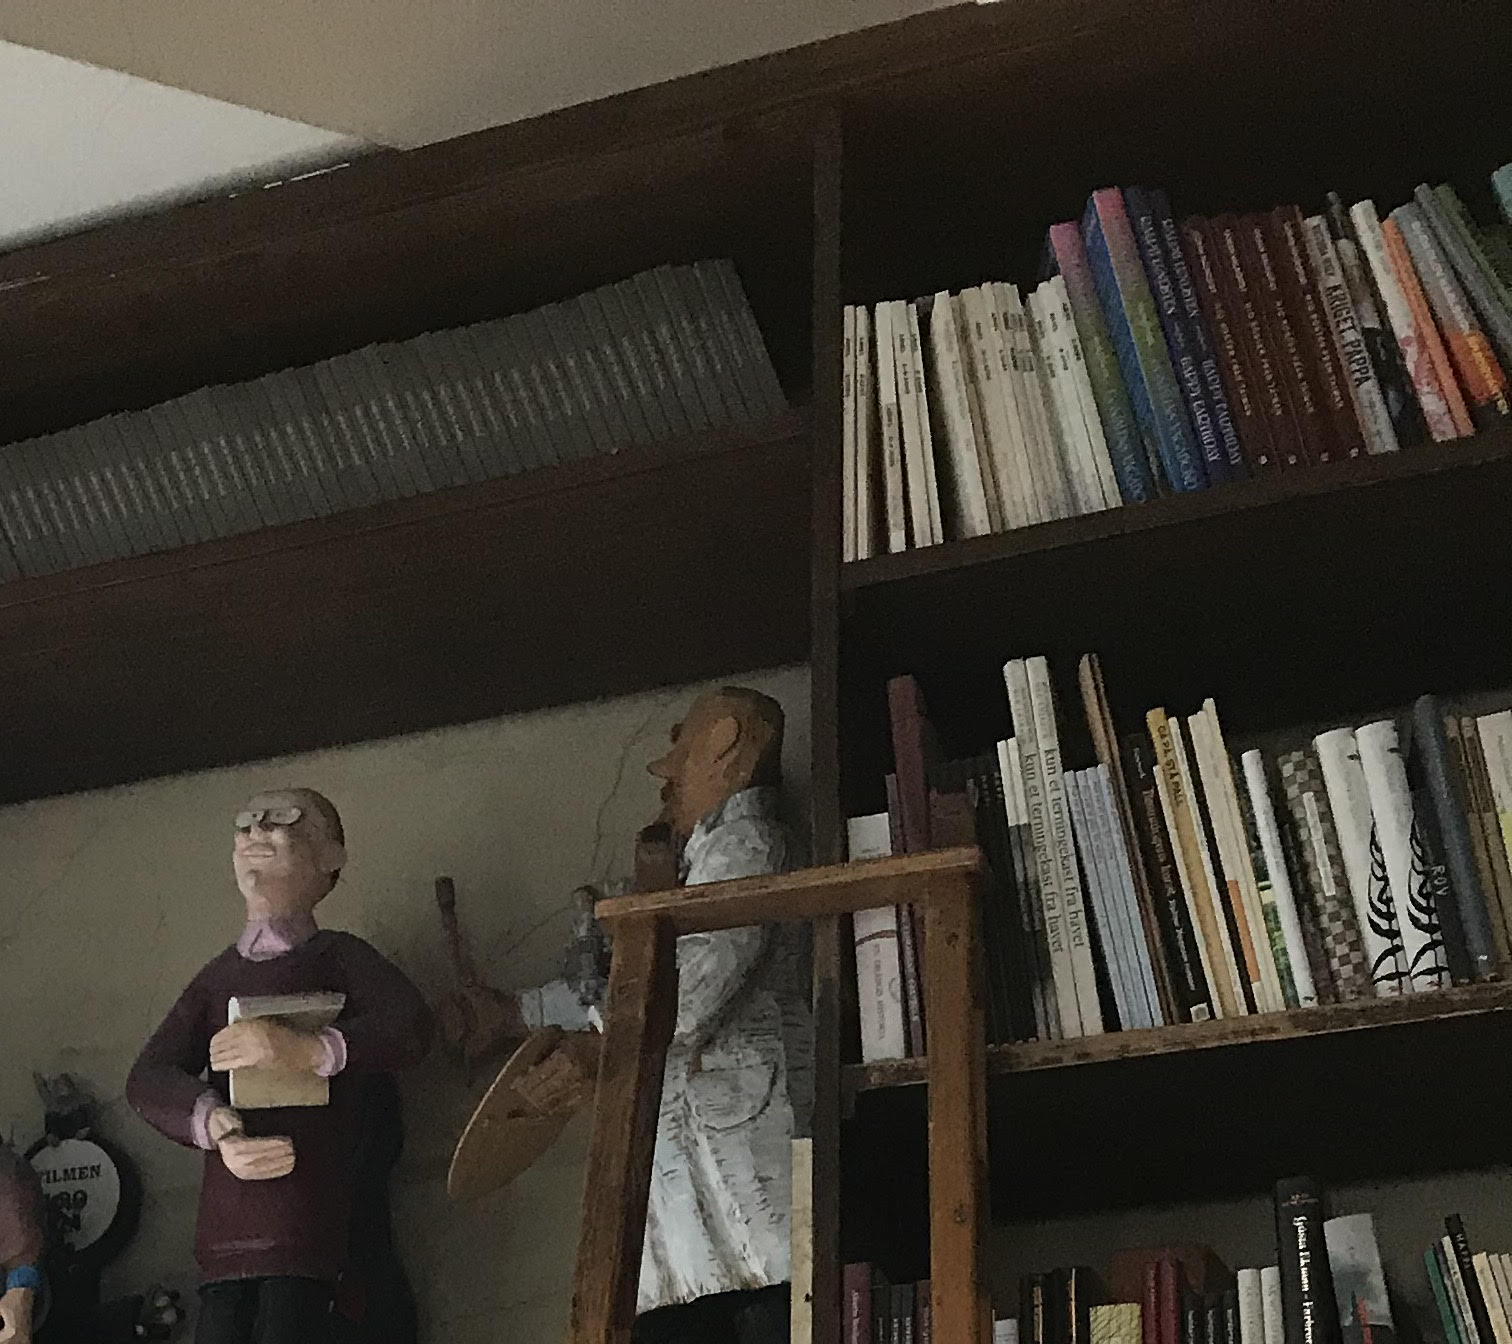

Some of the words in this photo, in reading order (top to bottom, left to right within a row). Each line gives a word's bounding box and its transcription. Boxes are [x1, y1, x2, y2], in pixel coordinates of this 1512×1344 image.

[1344, 340, 1370, 387] PAPPA
[1024, 753, 1039, 778] kun
[1044, 749, 1060, 776] kun
[1031, 801, 1054, 887] terningekast
[1050, 797, 1073, 882] terningekast
[1045, 891, 1058, 910] fra
[1065, 886, 1079, 906] fra
[1048, 914, 1064, 953] havet
[1069, 911, 1085, 948] havet
[41, 1163, 101, 1185] ILMEN
